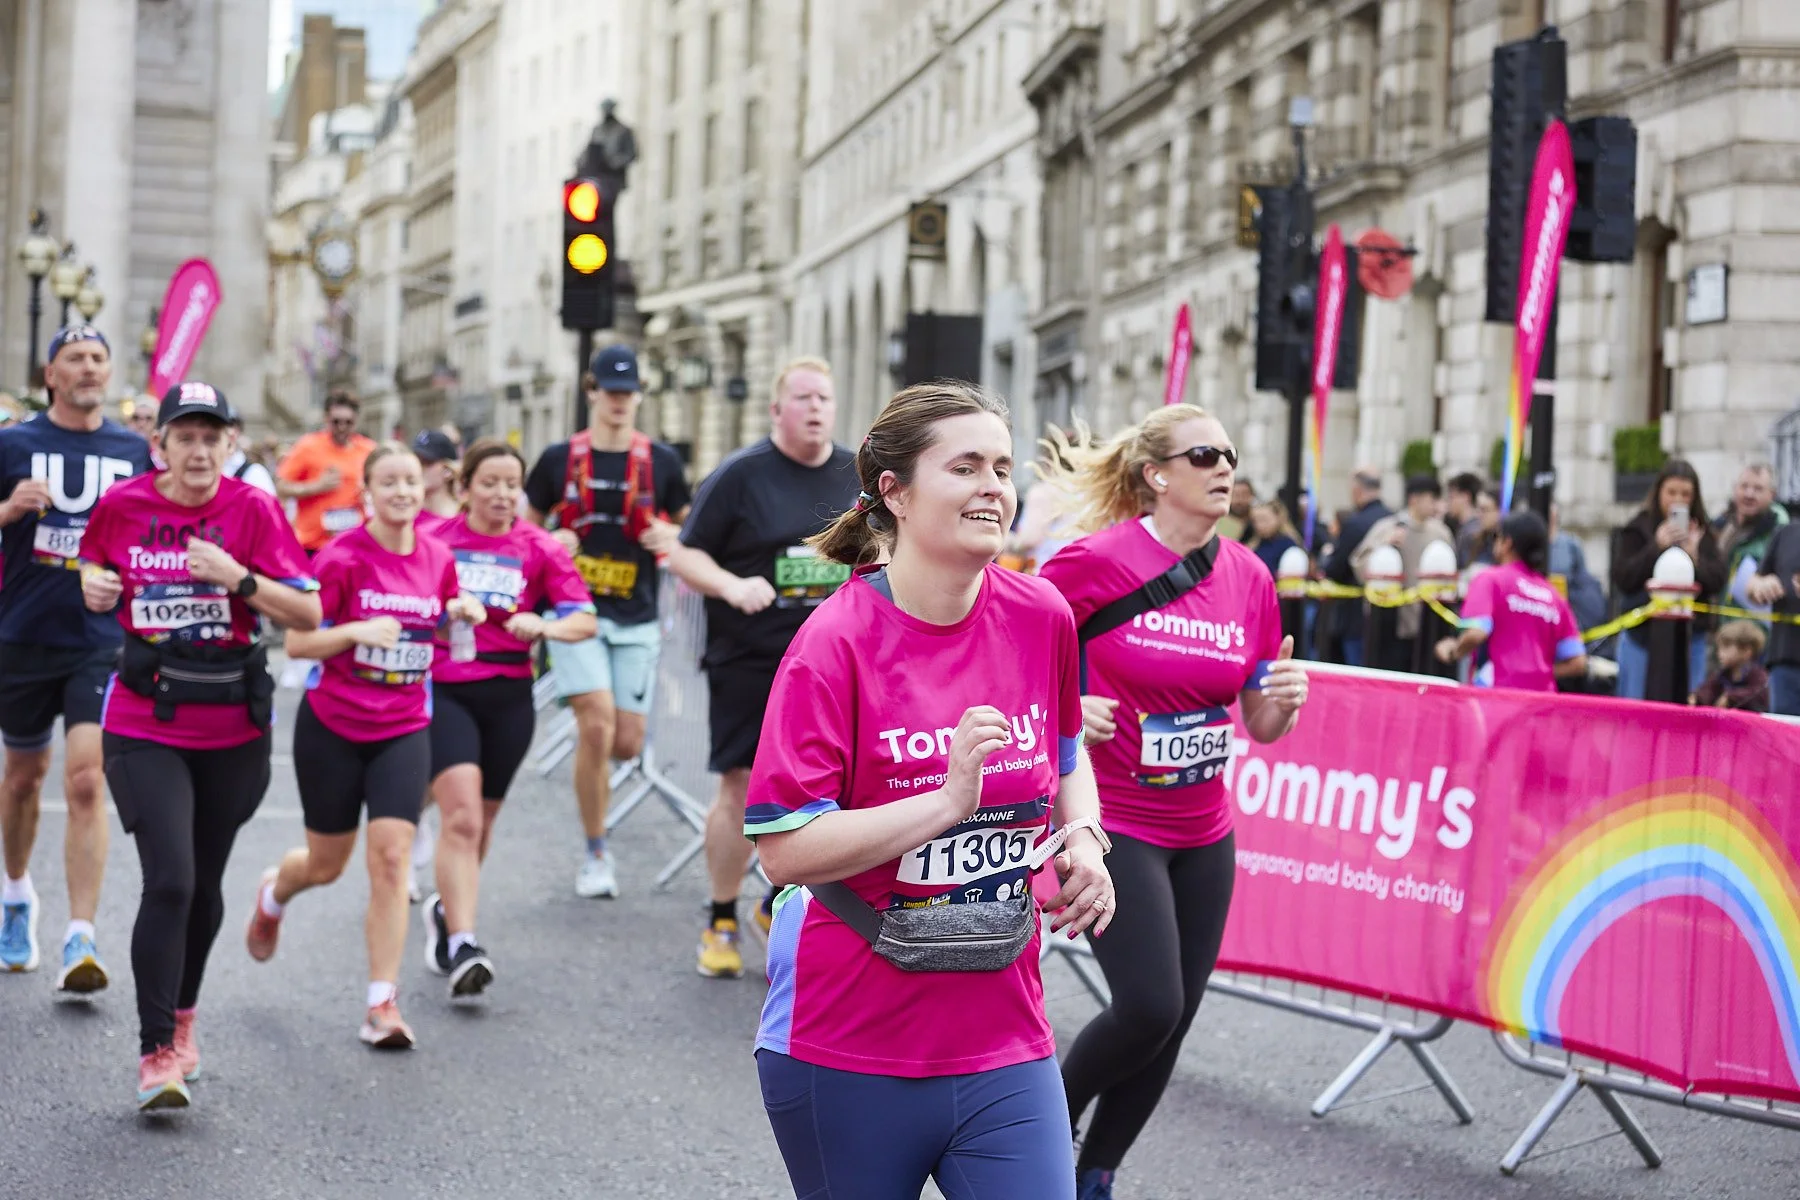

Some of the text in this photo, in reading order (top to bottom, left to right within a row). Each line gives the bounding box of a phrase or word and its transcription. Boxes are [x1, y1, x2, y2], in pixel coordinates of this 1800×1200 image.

[142, 603, 222, 622] 10256
[879, 703, 1049, 764] Toy'
[1152, 730, 1228, 762] 10564
[886, 779, 911, 789] The
[980, 761, 1004, 776] and
[1004, 757, 1034, 771] baby
[957, 810, 1016, 826] OXANNE
[1222, 737, 1477, 860] Tommy's
[915, 829, 1035, 881] 11305
[1234, 849, 1466, 914] regnancy and baby charity
